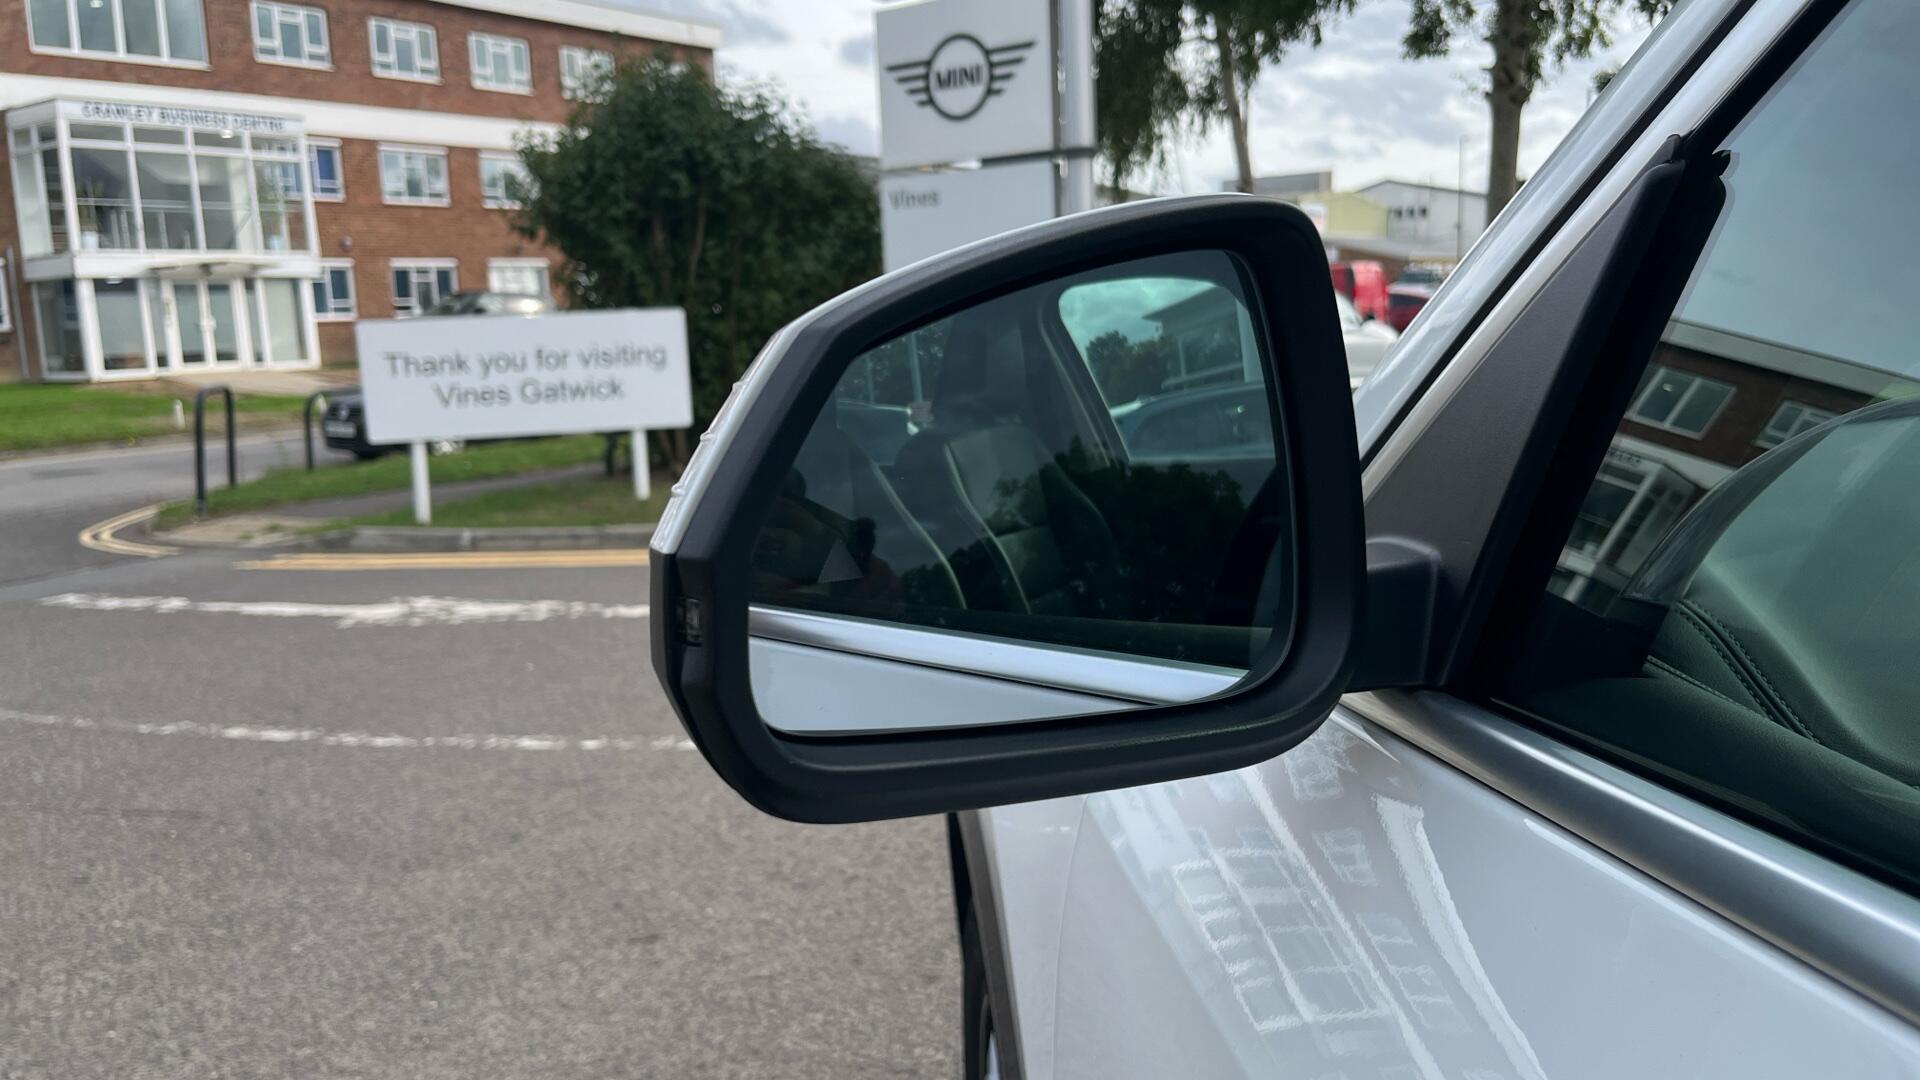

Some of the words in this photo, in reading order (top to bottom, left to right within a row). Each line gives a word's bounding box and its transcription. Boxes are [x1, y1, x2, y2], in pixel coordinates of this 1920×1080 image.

[934, 63, 984, 90] MINI
[81, 101, 153, 121] CRAWLEY
[158, 106, 227, 128] BUSINESS
[231, 113, 286, 131] CENTRE
[888, 189, 939, 209] Vines
[384, 350, 470, 377] Thank
[480, 350, 528, 379] you
[536, 345, 570, 372] for
[579, 340, 668, 370] visiting
[432, 379, 512, 407] Vines
[520, 377, 624, 405] Gatwick
